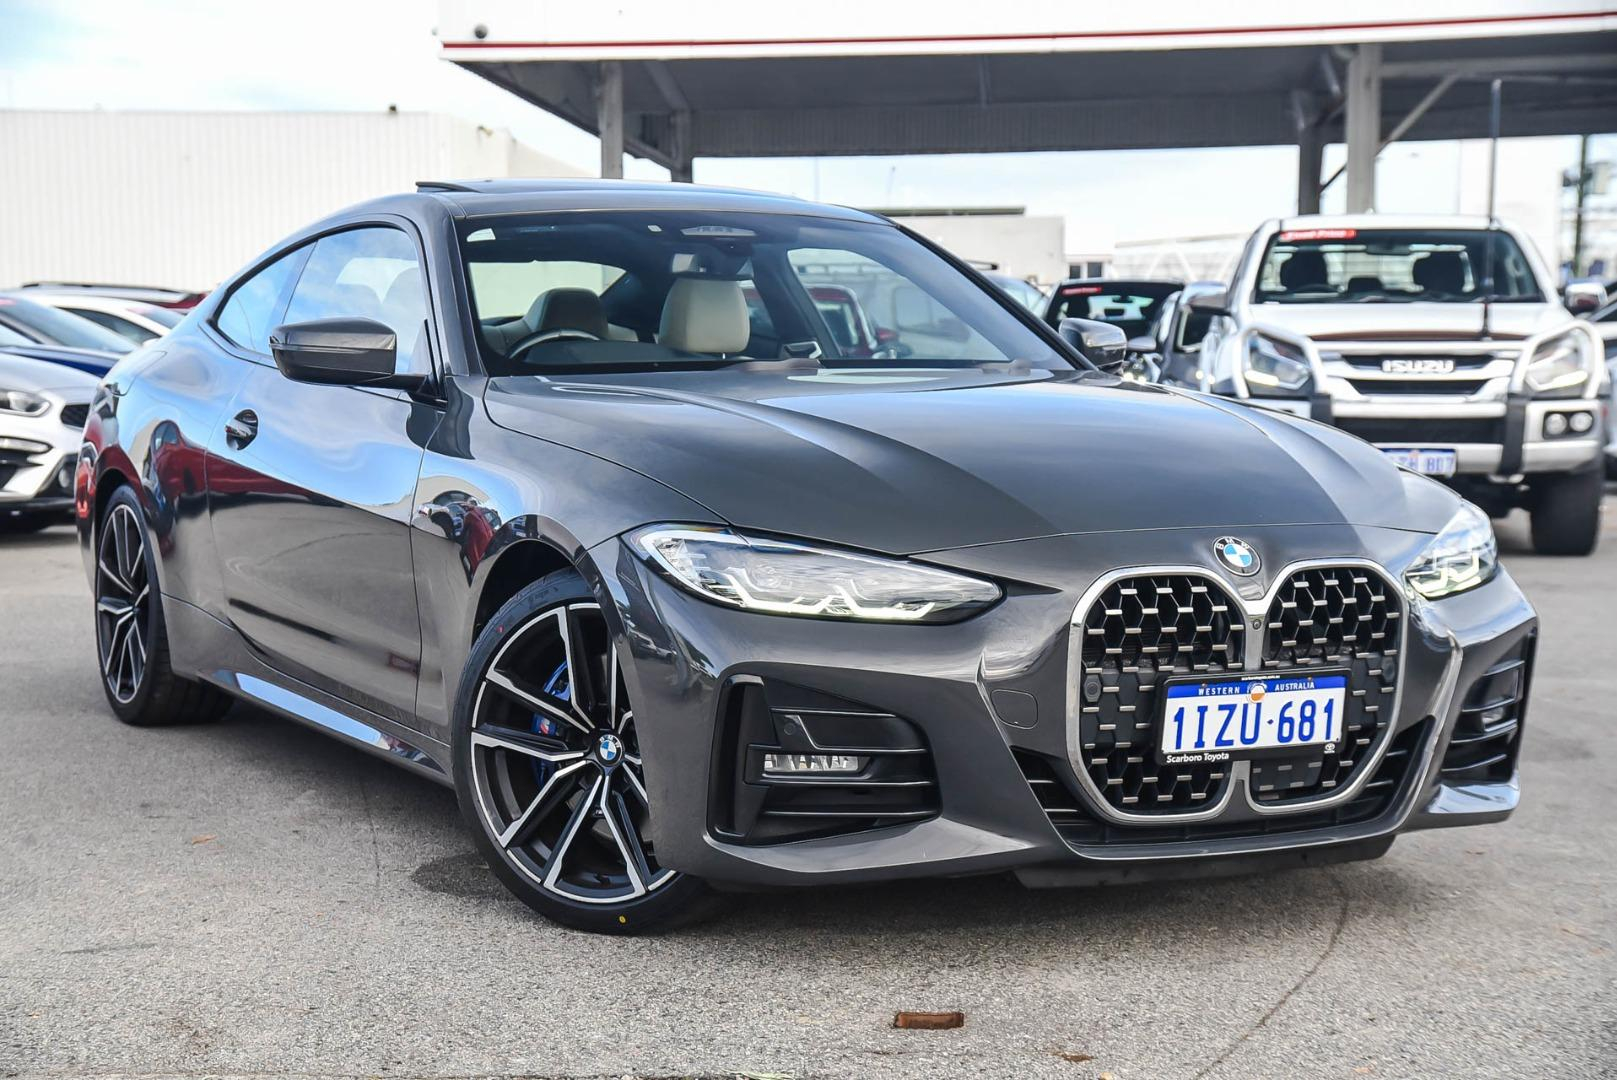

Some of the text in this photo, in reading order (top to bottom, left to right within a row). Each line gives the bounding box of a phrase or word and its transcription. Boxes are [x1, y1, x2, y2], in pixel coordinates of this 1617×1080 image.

[1382, 360, 1454, 373] ISUZU
[1216, 537, 1250, 549] BMW
[1198, 681, 1315, 696] WESTERN AUSTRALIA
[1166, 752, 1229, 763] Scarboro Toyota
